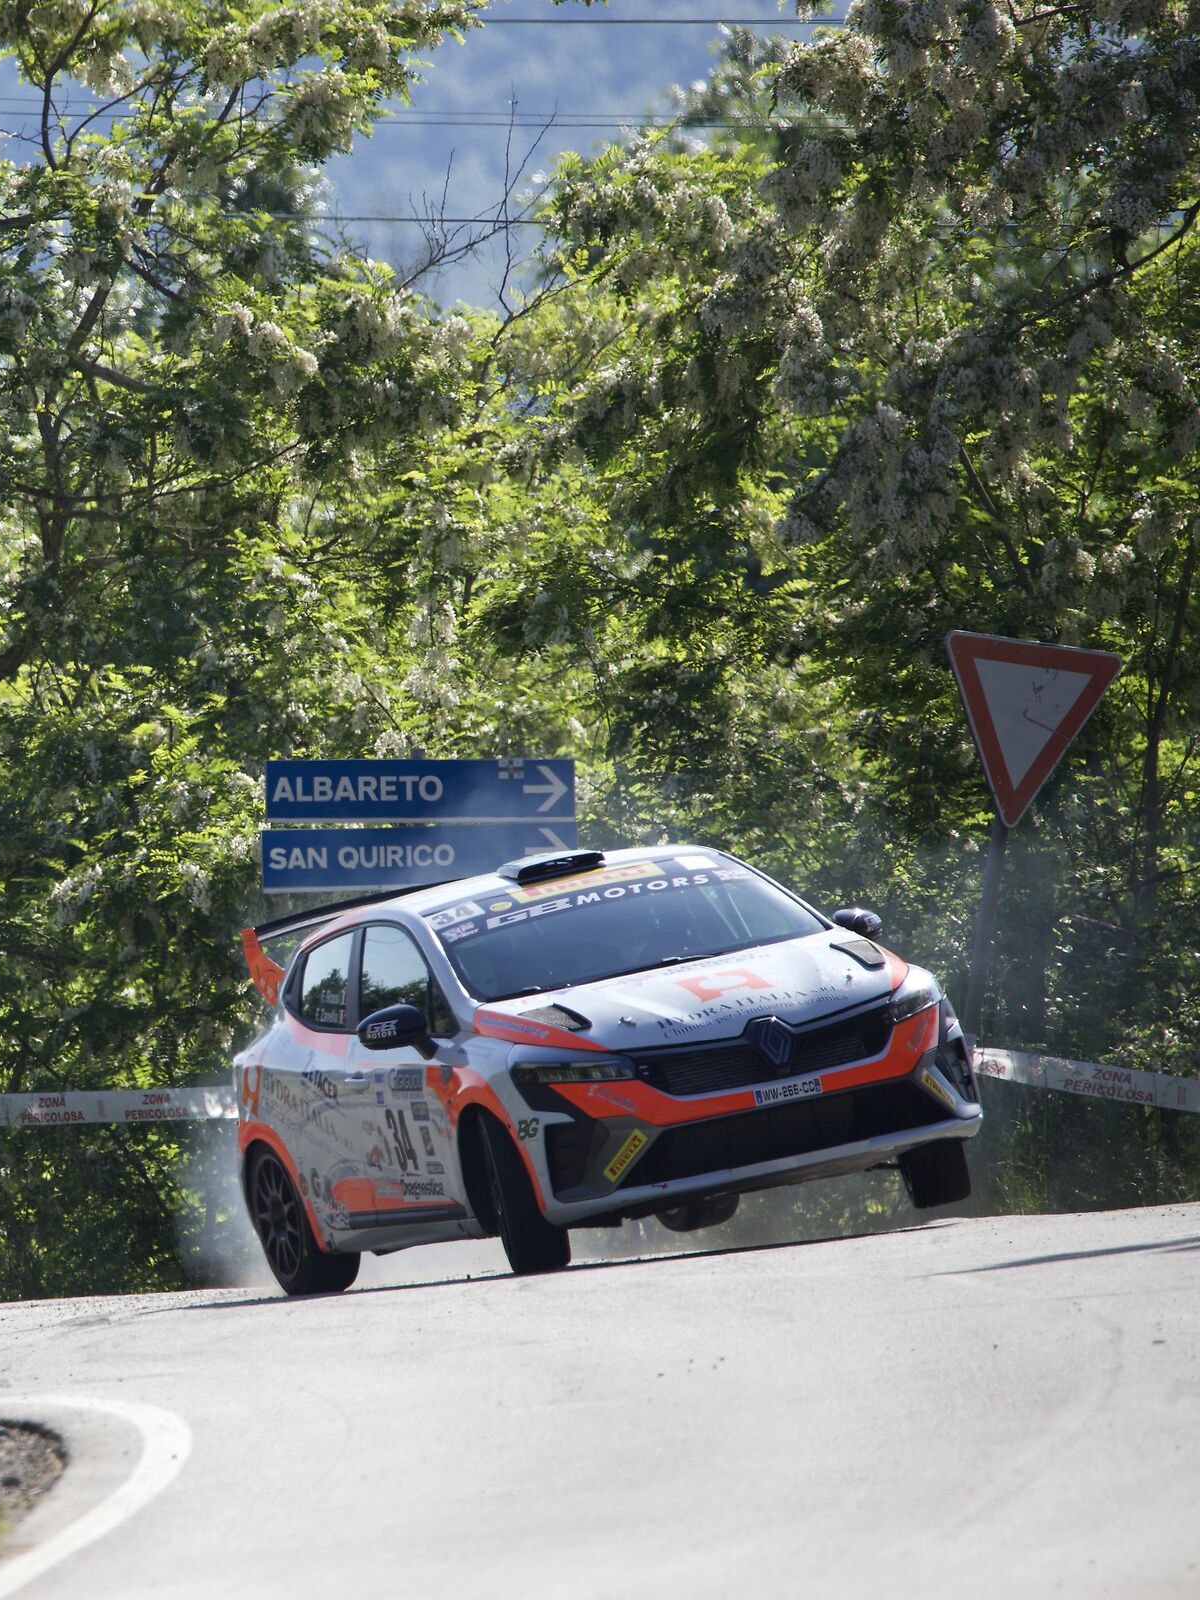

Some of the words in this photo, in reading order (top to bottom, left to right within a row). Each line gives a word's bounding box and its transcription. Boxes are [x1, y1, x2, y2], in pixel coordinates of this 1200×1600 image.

[272, 775, 444, 802] ALBARETO
[269, 847, 328, 870] SAN
[338, 845, 455, 870] QUIRICO
[577, 874, 709, 906] MOTORS
[431, 904, 475, 926] 34
[657, 1003, 732, 1030] HYDRA
[735, 990, 808, 1007] ITALIA
[664, 1022, 713, 1040] Chimica
[715, 1014, 733, 1026] per
[798, 994, 849, 1005] ceramica
[367, 1030, 398, 1039] MOTORS
[1092, 1068, 1133, 1085] ZONA
[38, 1097, 66, 1108] ZONA
[142, 1094, 171, 1105] ZONA
[762, 1080, 815, 1102] WW-266-CC
[1063, 1079, 1154, 1104] PERICOLOSA
[21, 1111, 85, 1124] PERICOLOSA
[125, 1108, 189, 1120] PERICOLOSA
[385, 1108, 419, 1172] 34
[518, 1117, 540, 1140] BG
[608, 1134, 643, 1177] PIRELLI
